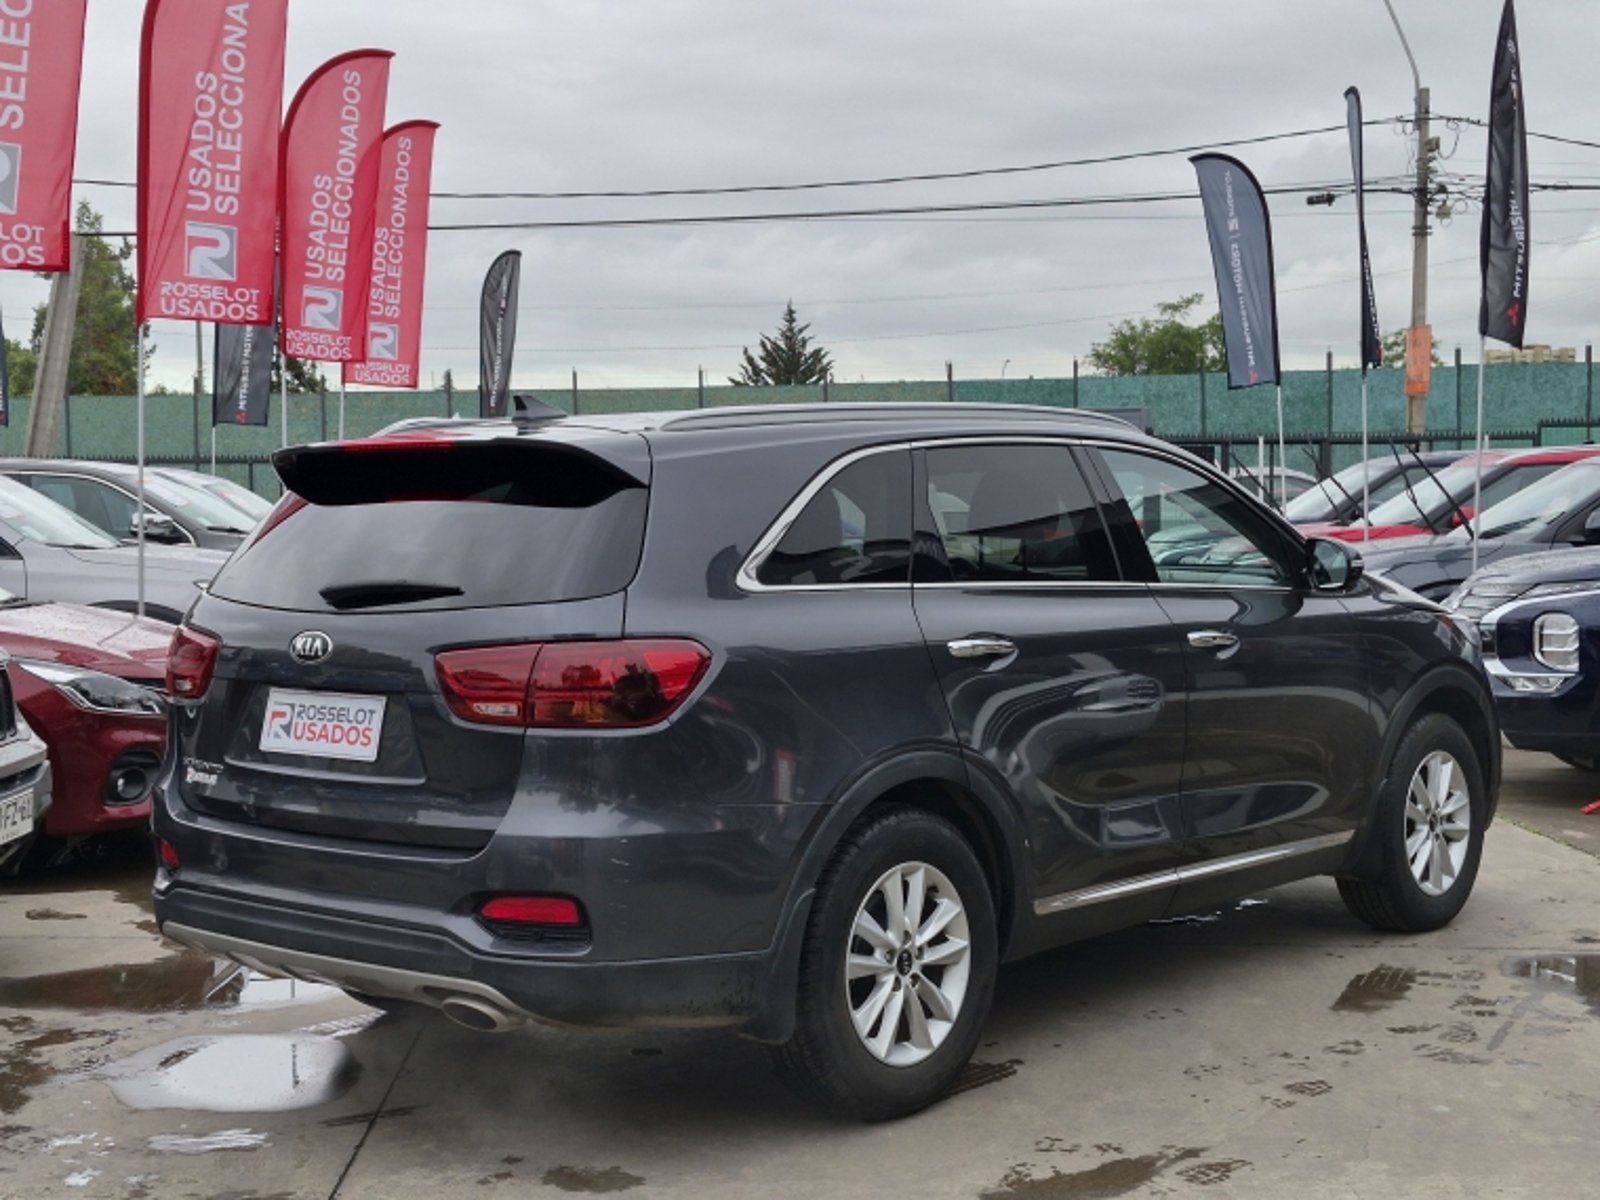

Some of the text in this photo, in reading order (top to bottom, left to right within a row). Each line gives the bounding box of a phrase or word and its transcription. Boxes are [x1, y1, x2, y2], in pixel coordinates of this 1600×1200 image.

[214, 2, 249, 216] SELECCIONA
[187, 71, 218, 211] USADOS
[326, 70, 361, 282] SELECCIONADOS
[304, 174, 332, 279] USADOS
[385, 136, 411, 318] SELECCIONADOS
[370, 227, 389, 316] USADOS
[161, 281, 260, 303] ROSSELOT
[161, 297, 259, 320] USADOS
[286, 328, 352, 346] ROSSELOT
[286, 341, 352, 360] USADOS
[354, 370, 410, 385] USADOS
[292, 637, 323, 656] KIA
[296, 704, 376, 725] ROSSELOT
[293, 722, 373, 746] USADOS
